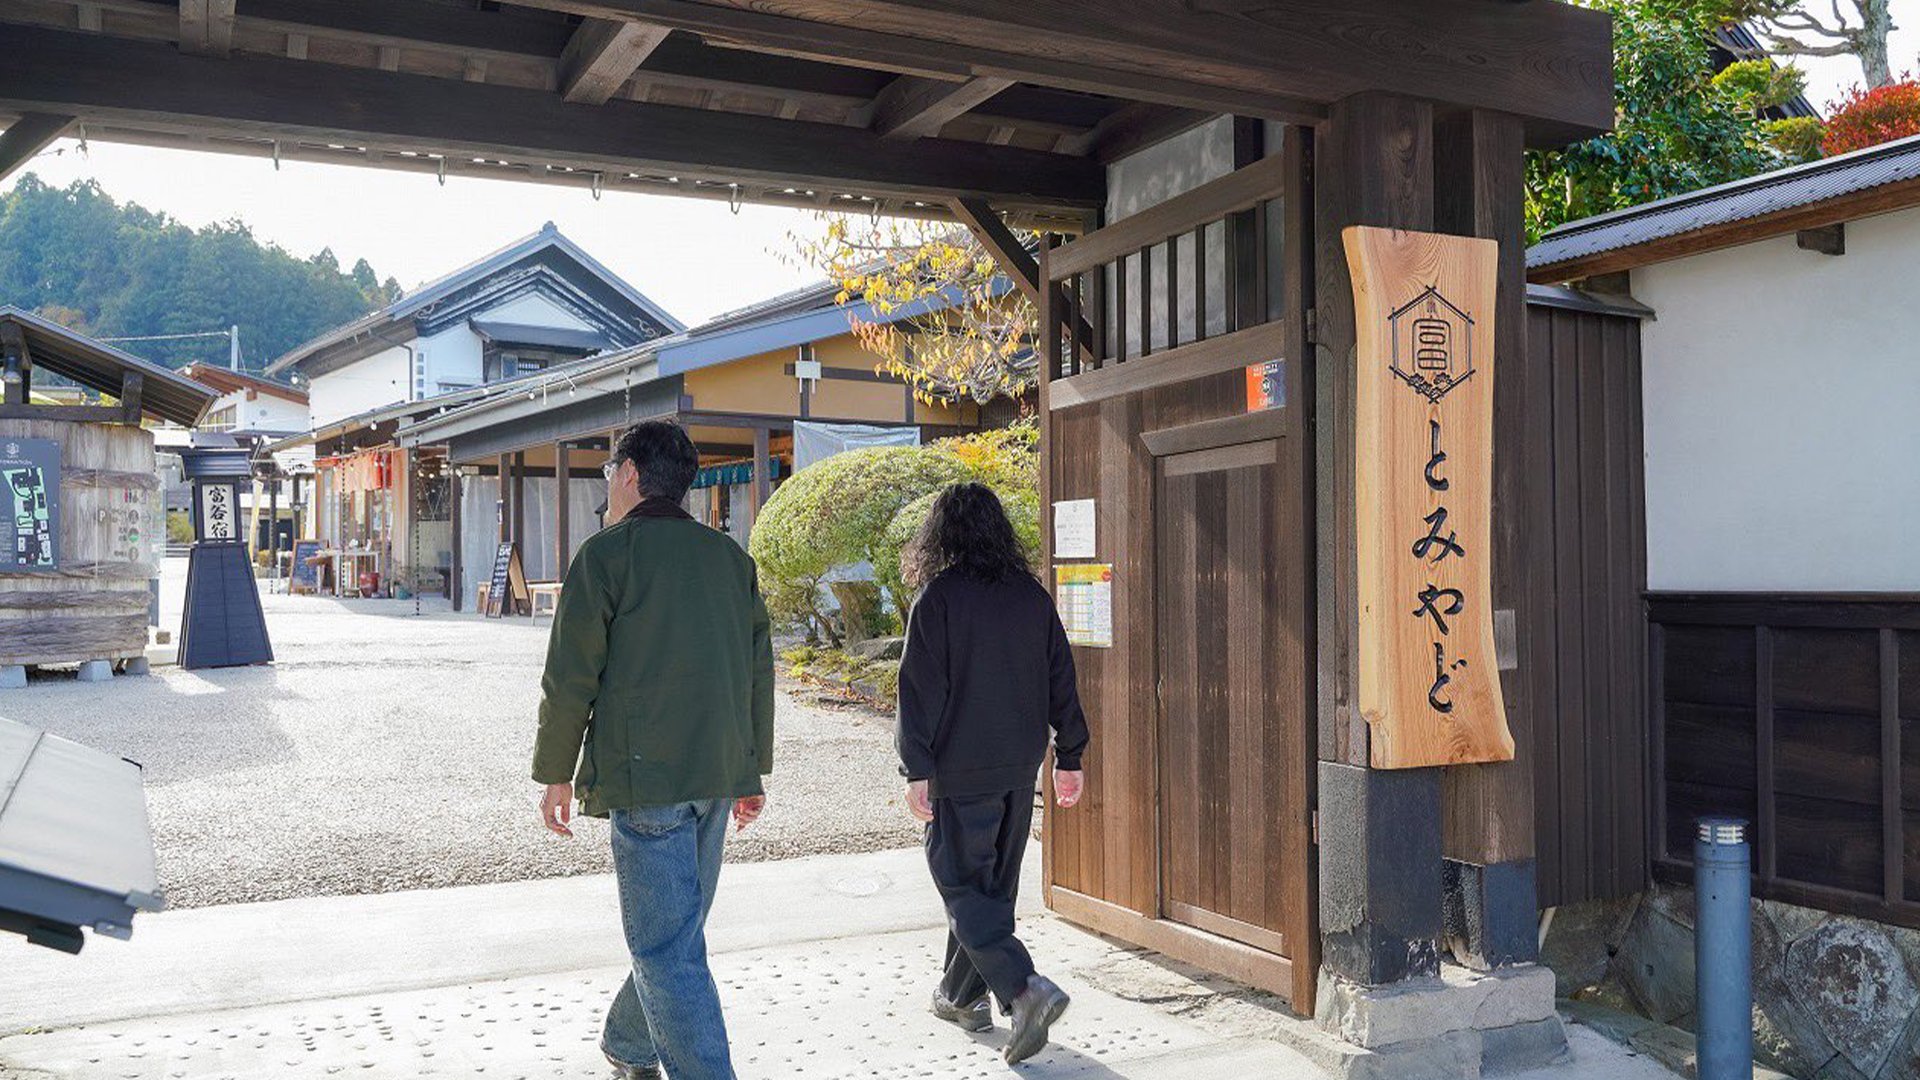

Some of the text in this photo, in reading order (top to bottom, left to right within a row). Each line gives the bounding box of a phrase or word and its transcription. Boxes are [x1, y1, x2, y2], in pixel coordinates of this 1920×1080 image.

[208, 485, 228, 538] 富谷宿
[1411, 419, 1467, 714] とみやど
